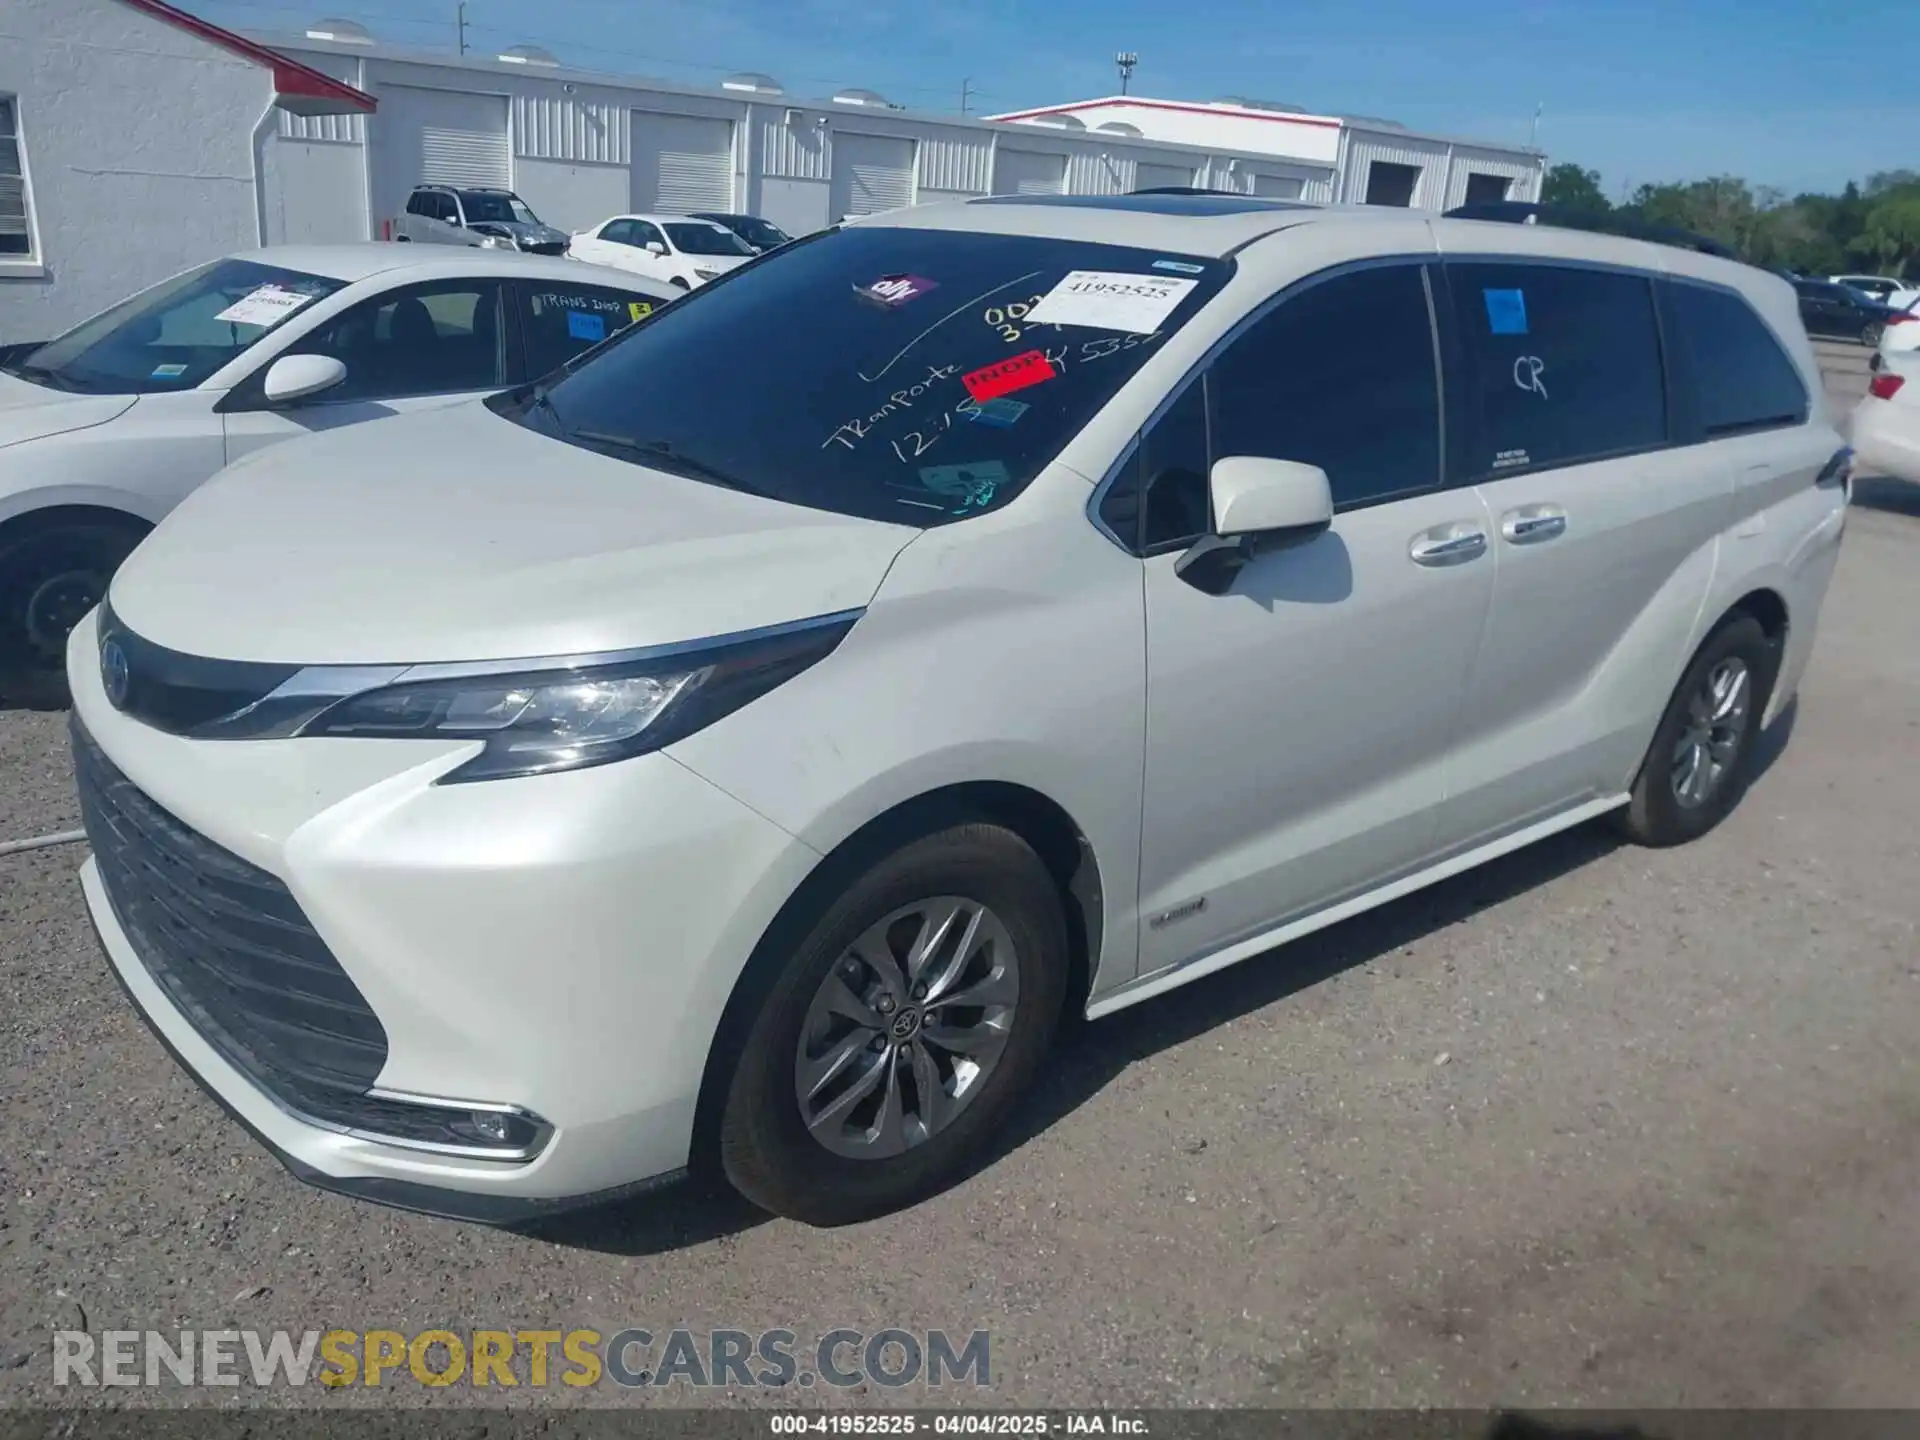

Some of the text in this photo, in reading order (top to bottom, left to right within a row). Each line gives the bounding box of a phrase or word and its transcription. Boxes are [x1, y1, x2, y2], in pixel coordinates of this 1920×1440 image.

[1067, 281, 1171, 299] 41952525
[968, 354, 1042, 386] INOP
[1514, 355, 1548, 400] CR
